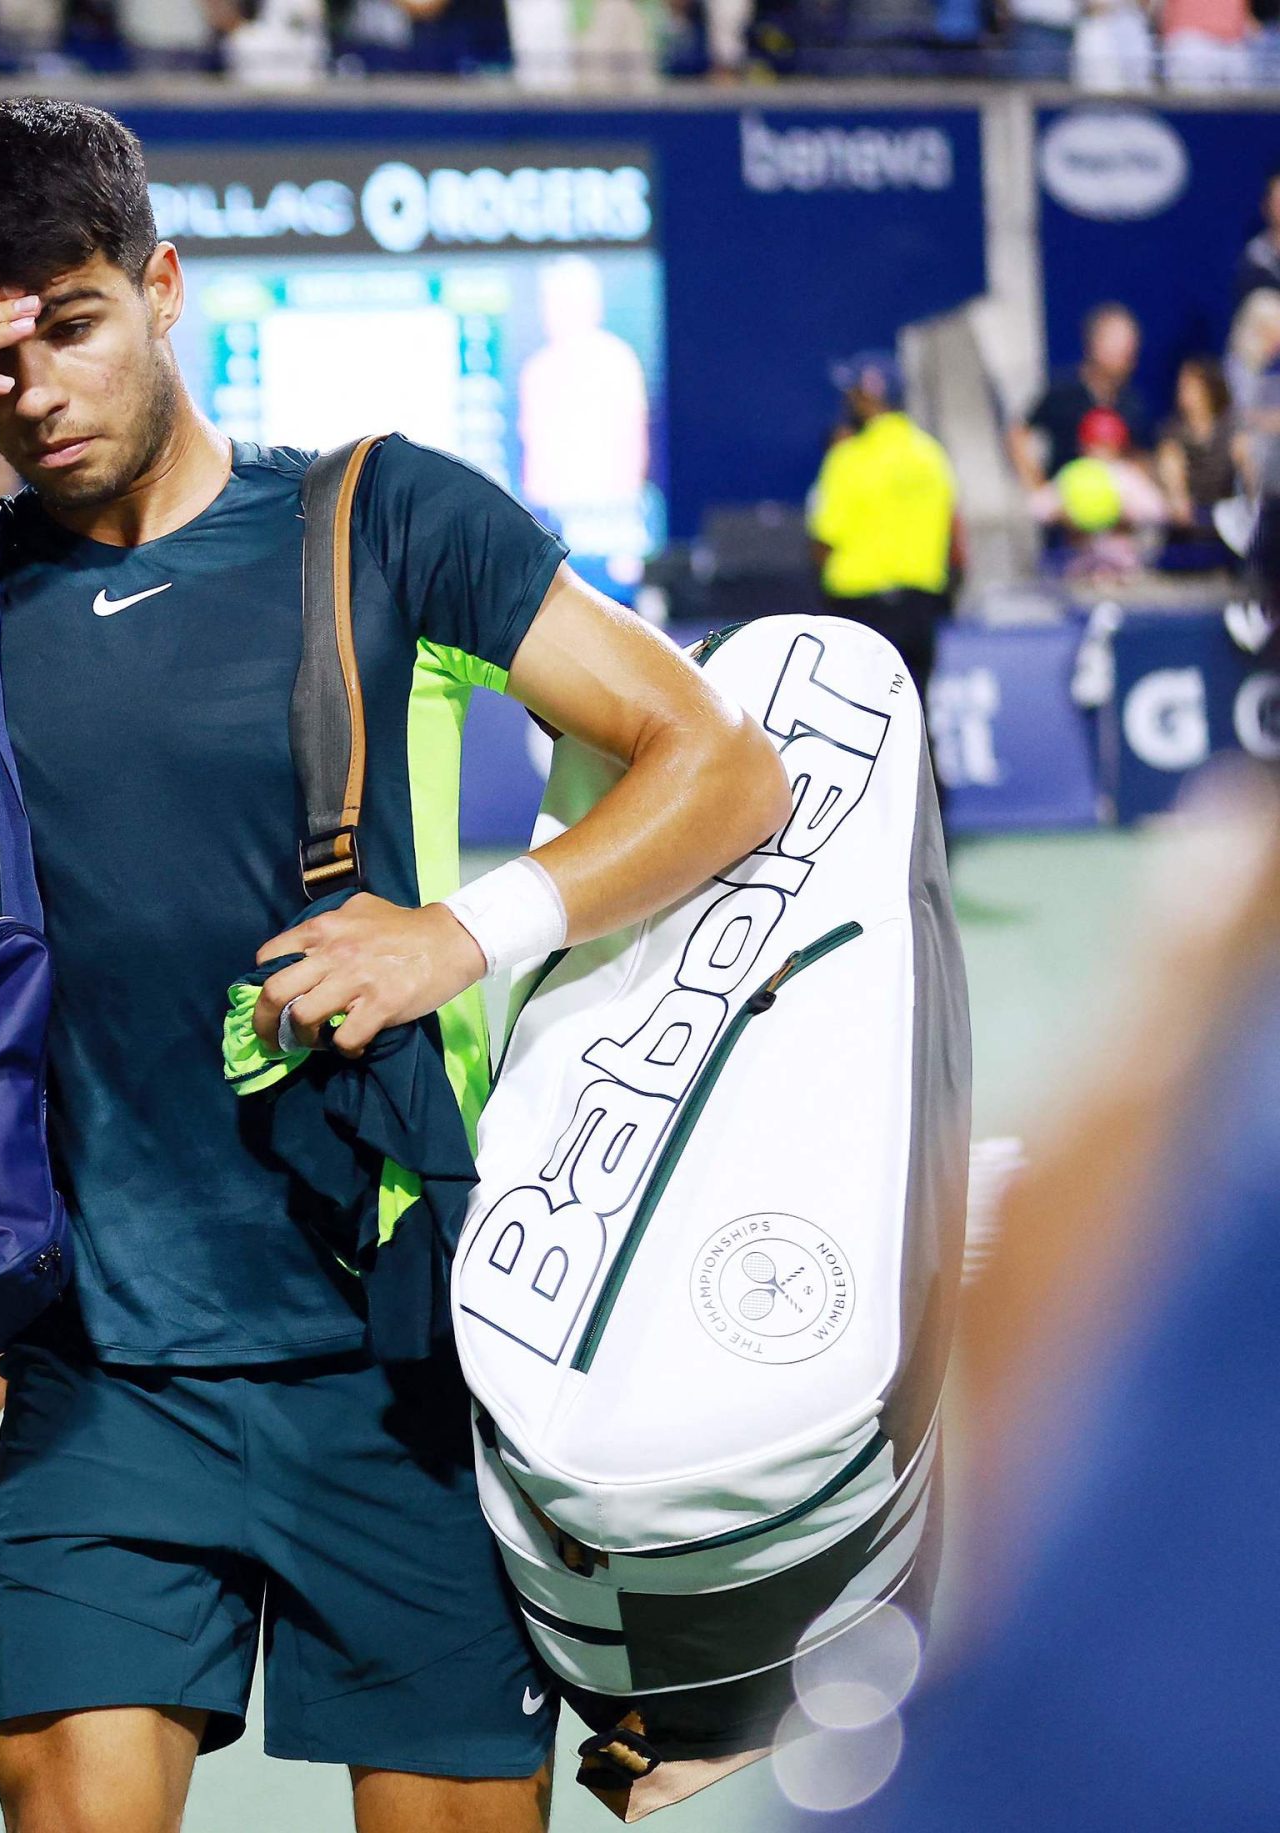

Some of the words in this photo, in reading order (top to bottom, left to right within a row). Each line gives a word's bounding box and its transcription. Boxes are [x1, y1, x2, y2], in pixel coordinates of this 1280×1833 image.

[428, 167, 652, 243] ROGERS
[889, 673, 905, 695] TM
[700, 1221, 770, 1332] CHAMPIONSHIPS
[812, 1243, 846, 1340] WIMBLEDON
[728, 1332, 763, 1354] THE
